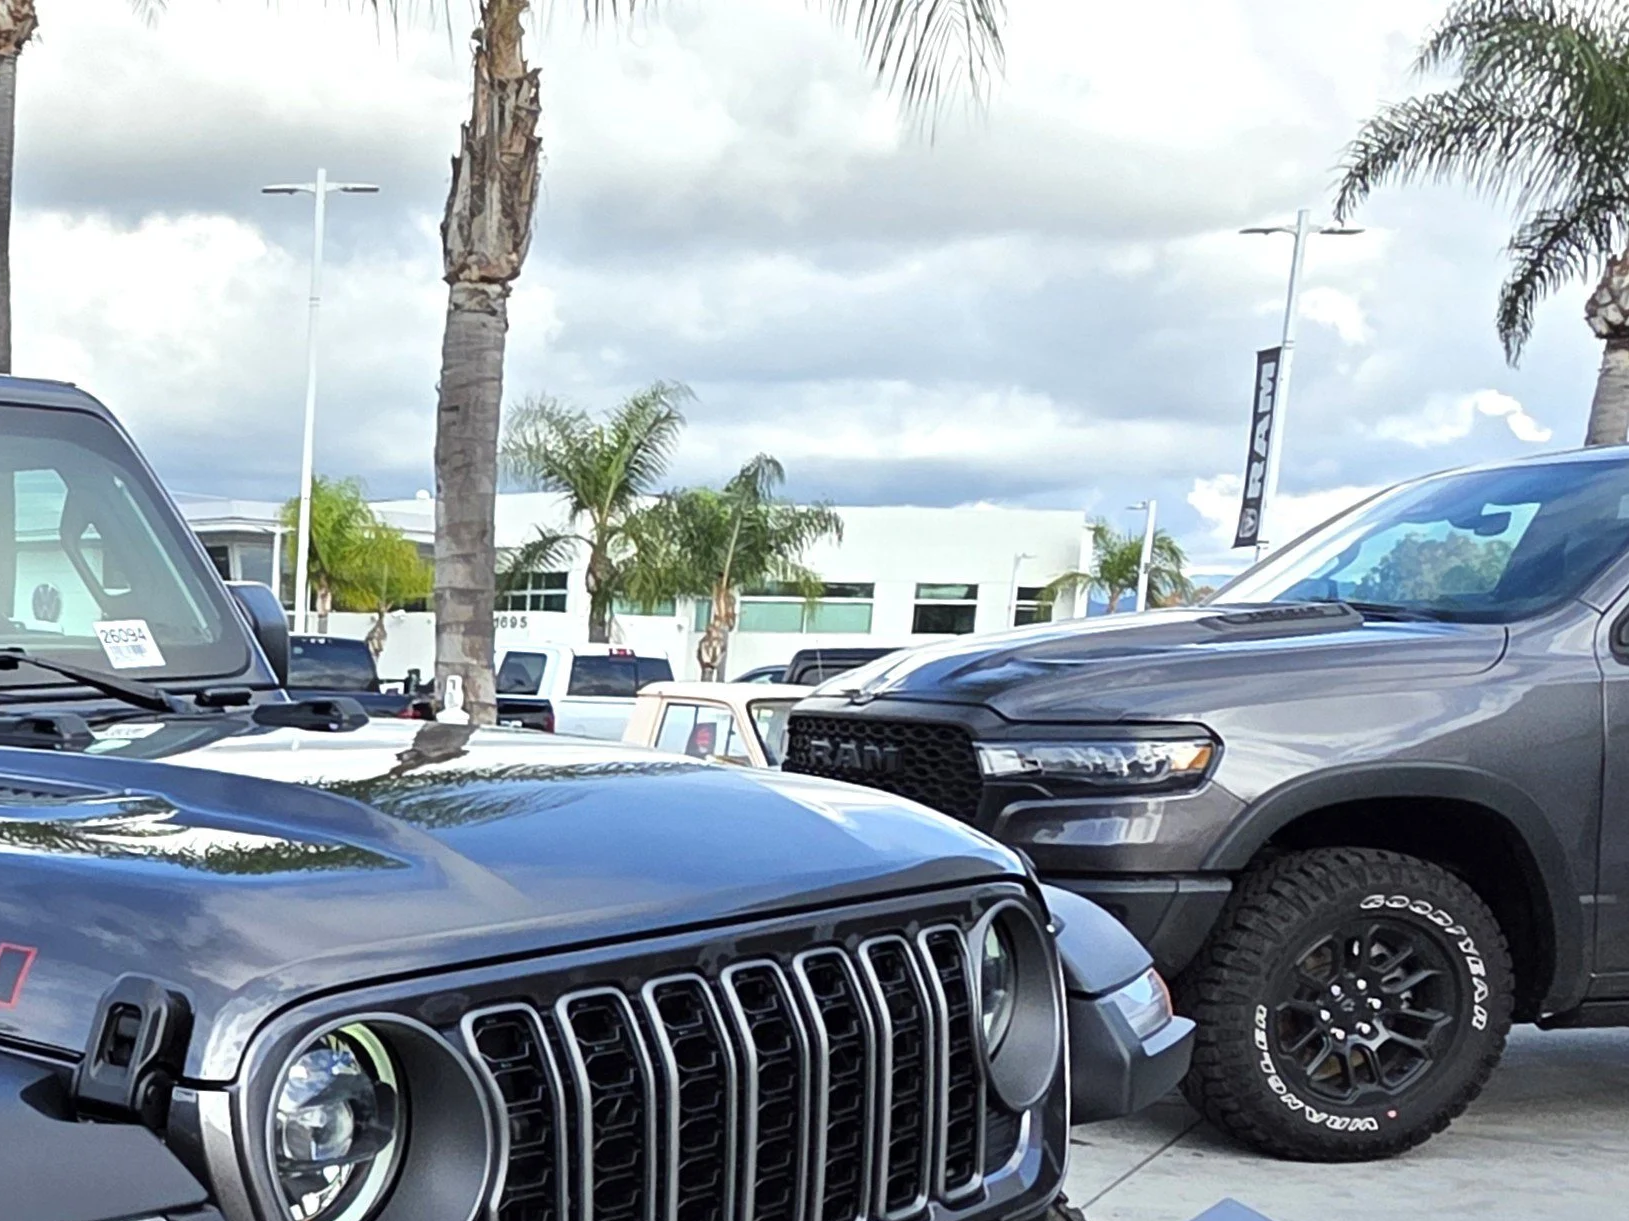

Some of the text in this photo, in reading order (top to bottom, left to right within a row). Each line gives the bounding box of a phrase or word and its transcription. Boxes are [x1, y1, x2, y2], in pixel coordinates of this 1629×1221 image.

[1246, 362, 1276, 499] RAM
[99, 627, 148, 644] 26094
[809, 738, 903, 773] RAM
[1360, 895, 1490, 1031] GOODYEAR
[1254, 1004, 1379, 1131] WRANGLER
